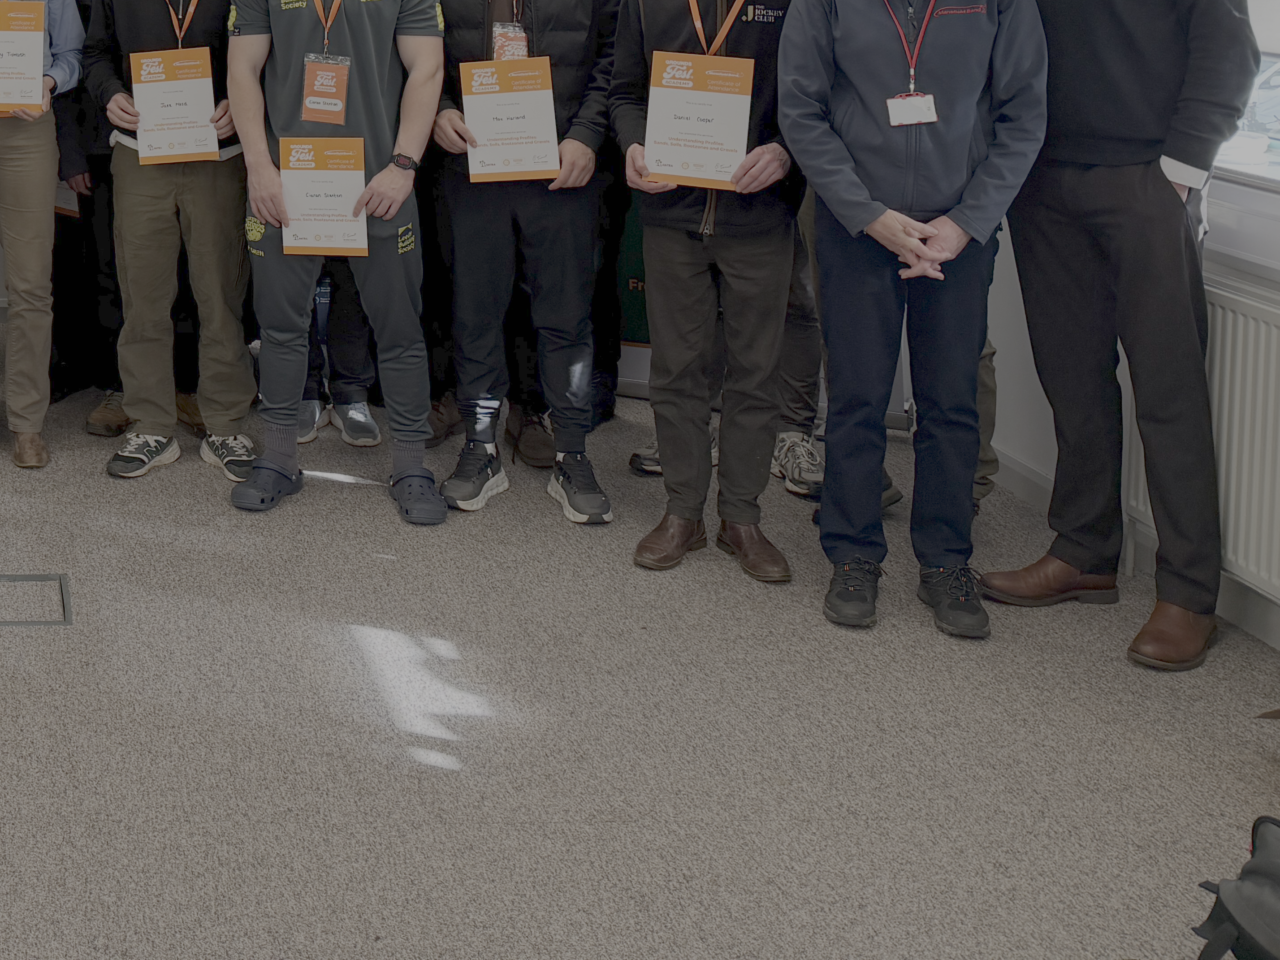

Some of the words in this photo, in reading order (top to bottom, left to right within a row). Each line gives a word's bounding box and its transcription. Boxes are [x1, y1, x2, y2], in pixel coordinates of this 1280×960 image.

[281, 1, 307, 10] Society
[663, 65, 693, 79] Fest
[471, 72, 498, 87] Fest
